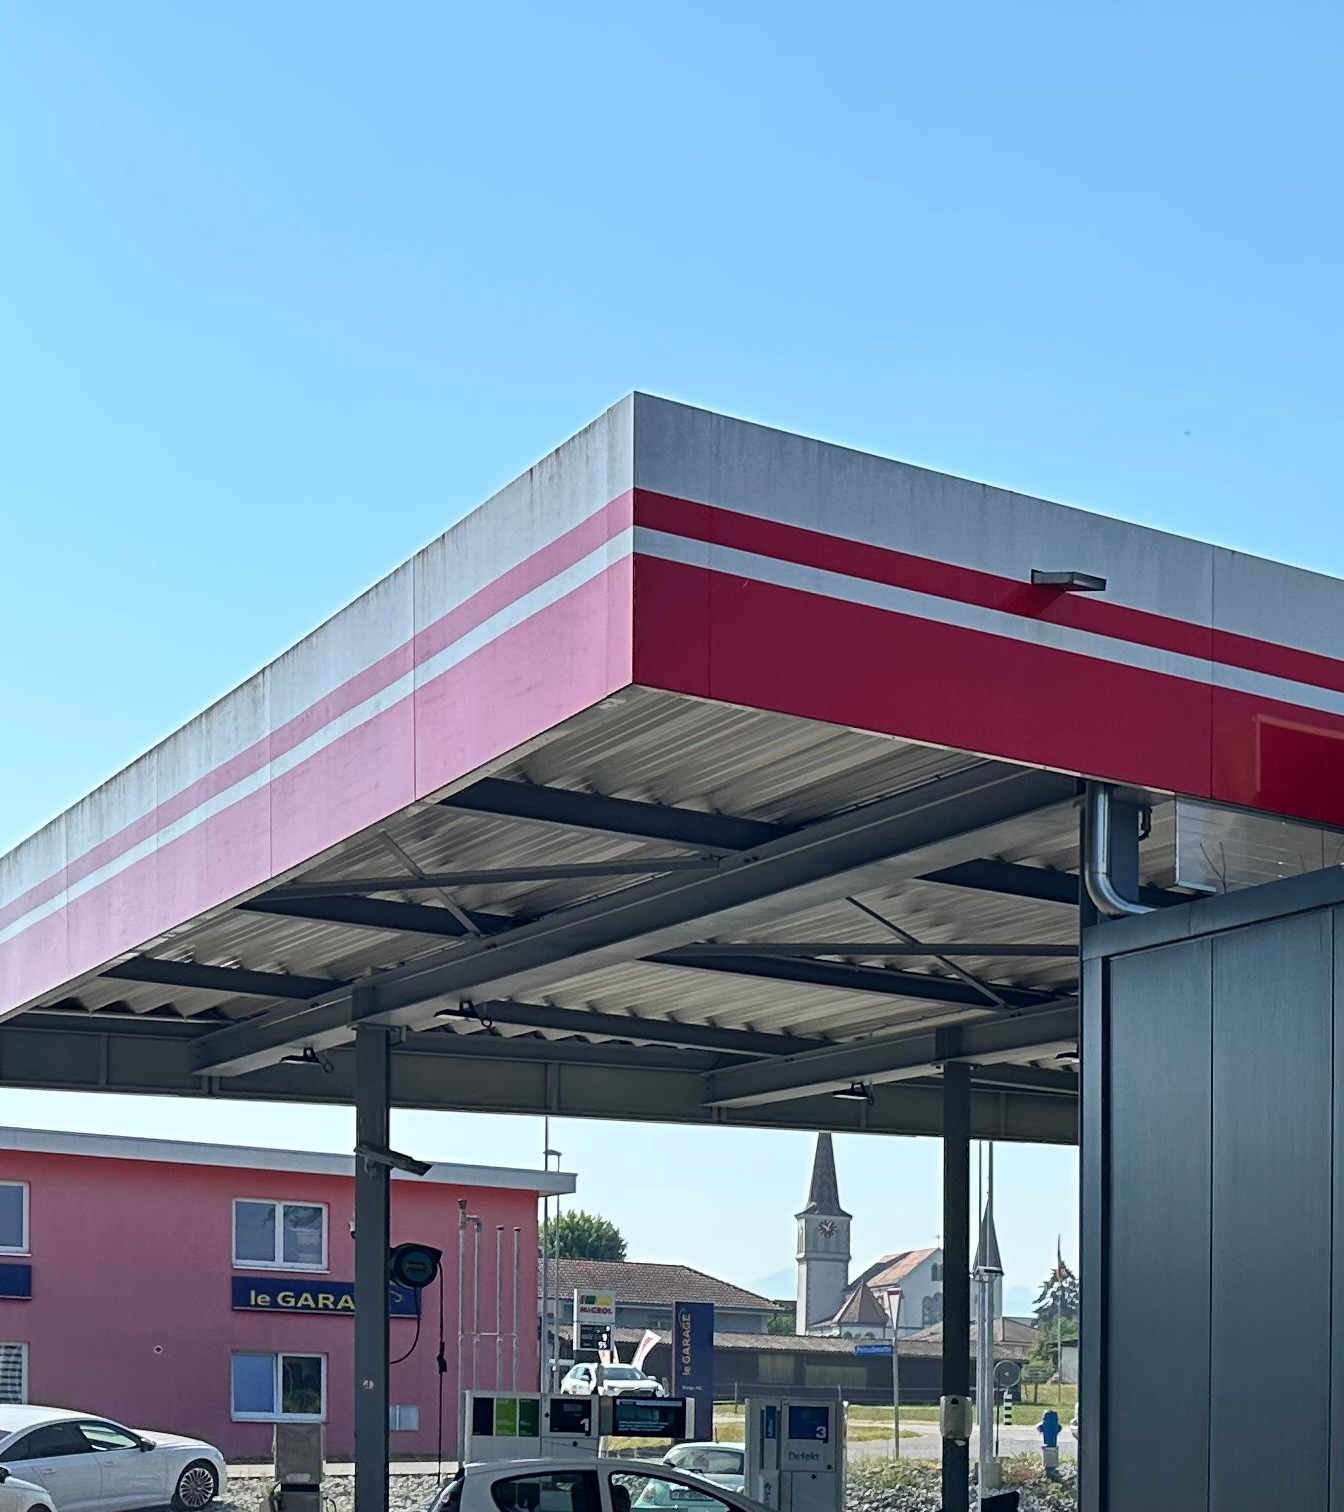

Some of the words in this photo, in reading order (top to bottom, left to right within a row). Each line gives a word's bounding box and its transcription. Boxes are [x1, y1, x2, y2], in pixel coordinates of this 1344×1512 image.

[250, 1290, 271, 1306] le
[277, 1291, 356, 1310] GARA
[682, 1313, 691, 1364] GARAGE
[682, 1365, 691, 1376] le
[580, 1418, 590, 1431] 1
[815, 1426, 827, 1439] 3
[788, 1451, 820, 1461] Defekt
